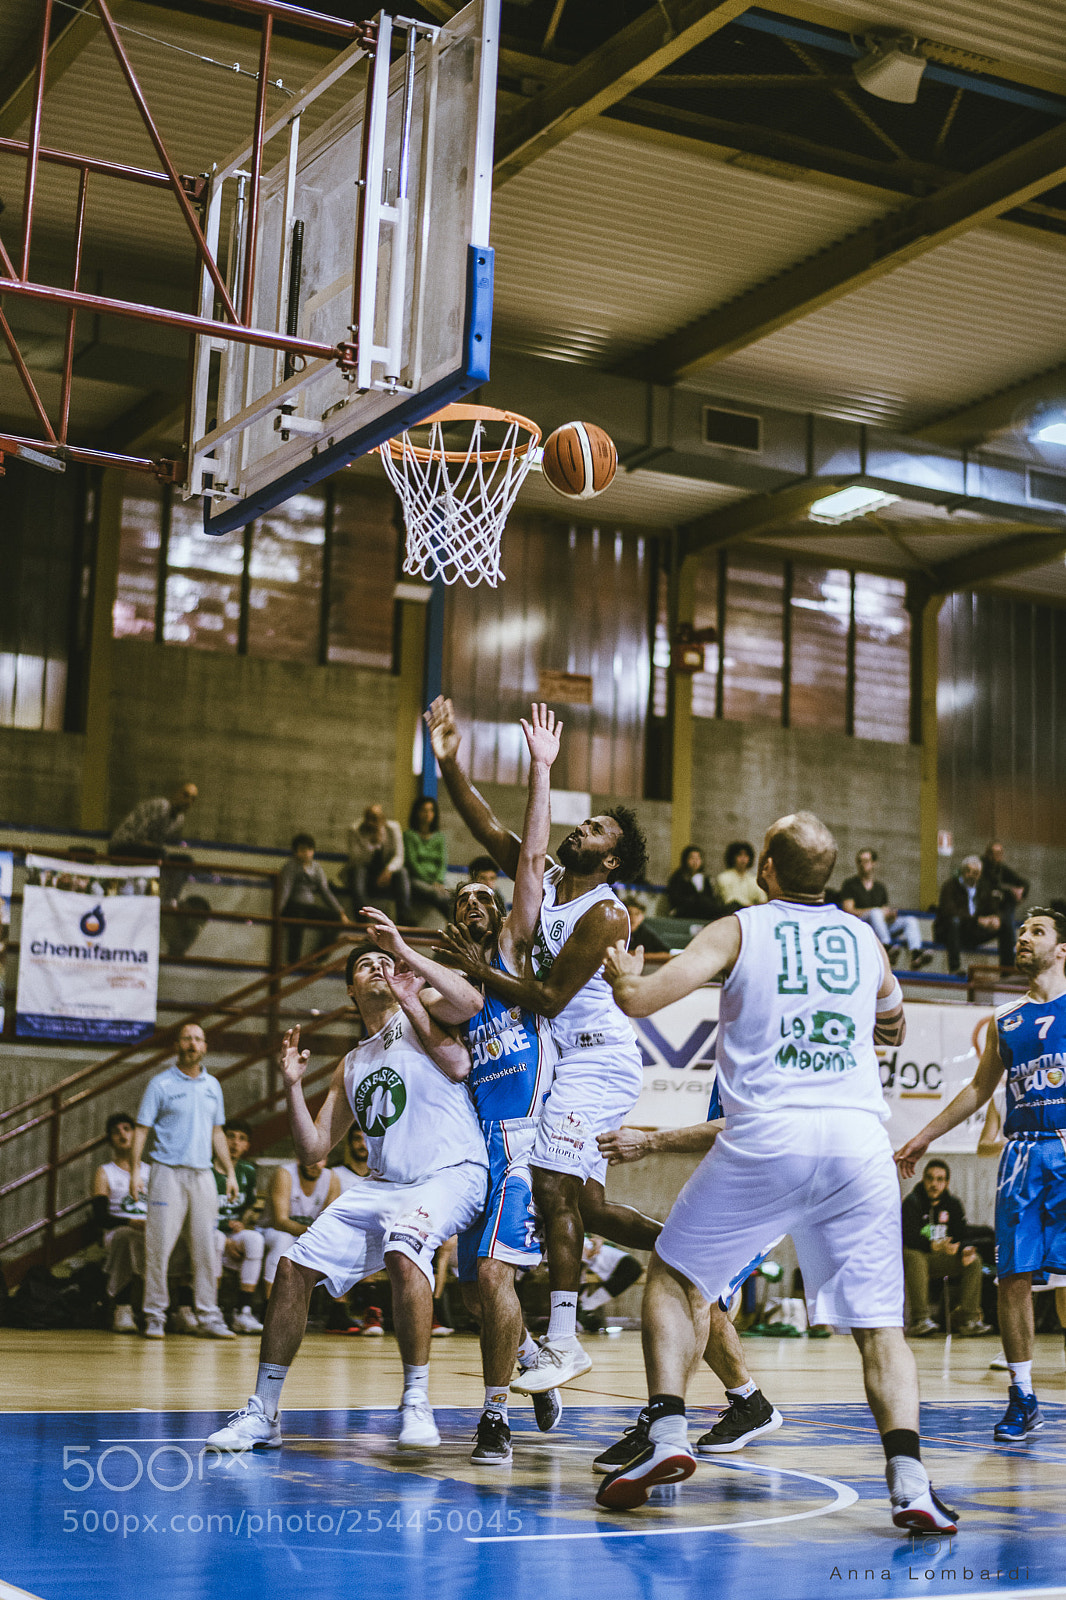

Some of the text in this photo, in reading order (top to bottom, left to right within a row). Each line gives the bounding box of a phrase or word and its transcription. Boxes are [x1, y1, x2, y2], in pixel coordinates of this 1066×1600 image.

[549, 919, 565, 941] 6
[30, 939, 149, 963] chemifarma
[774, 920, 860, 995] 19
[383, 1022, 403, 1051] 21
[1034, 1014, 1056, 1040] 7
[356, 1079, 373, 1112] GREEN
